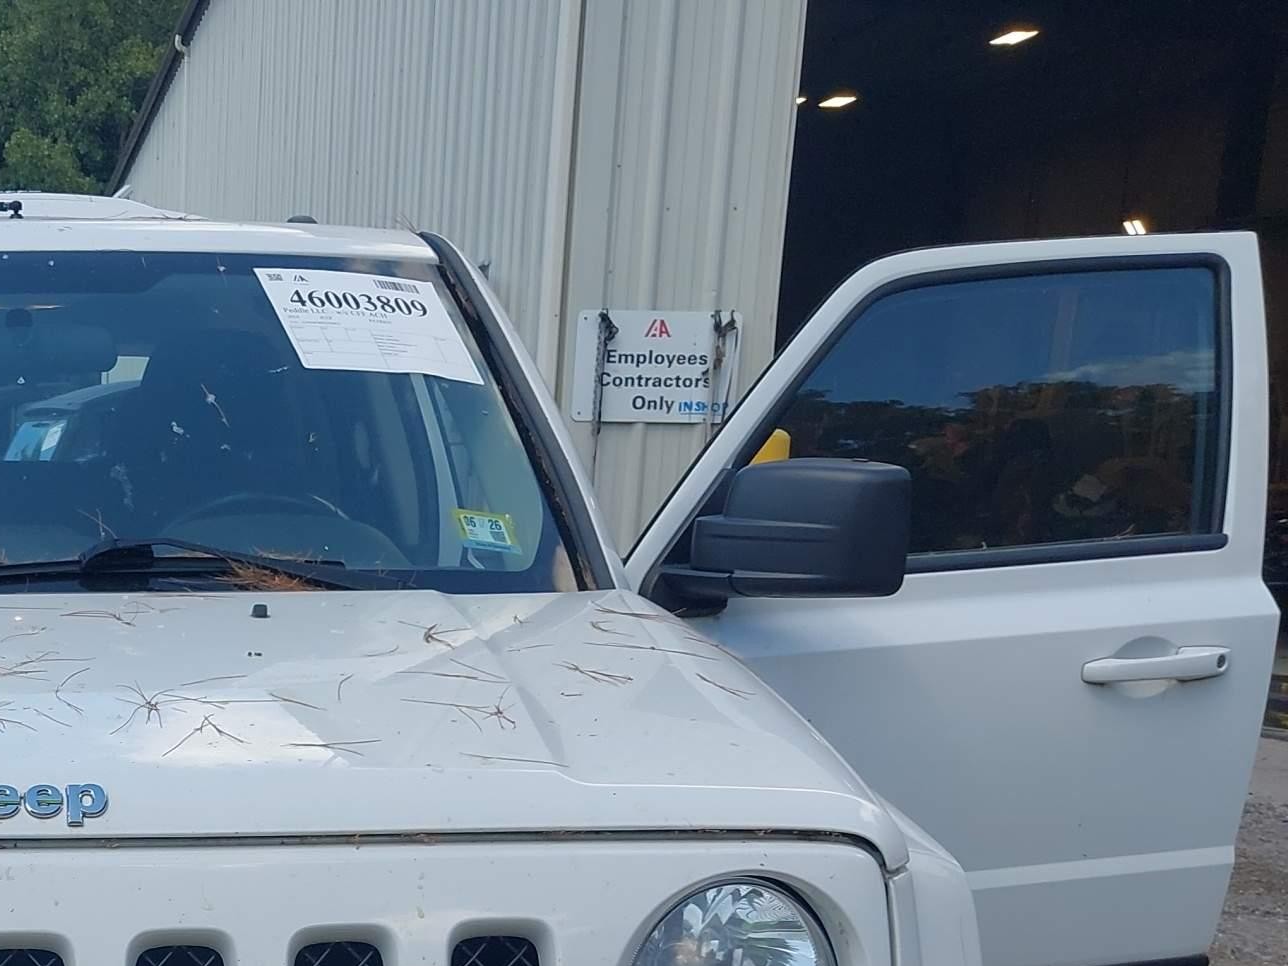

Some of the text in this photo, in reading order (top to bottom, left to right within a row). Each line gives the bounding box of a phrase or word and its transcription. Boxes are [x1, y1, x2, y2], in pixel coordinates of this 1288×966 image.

[290, 289, 428, 317] 46003809
[606, 350, 708, 368] Employees
[600, 372, 710, 388] Contractors
[632, 396, 674, 414] Only
[488, 519, 502, 531] 26
